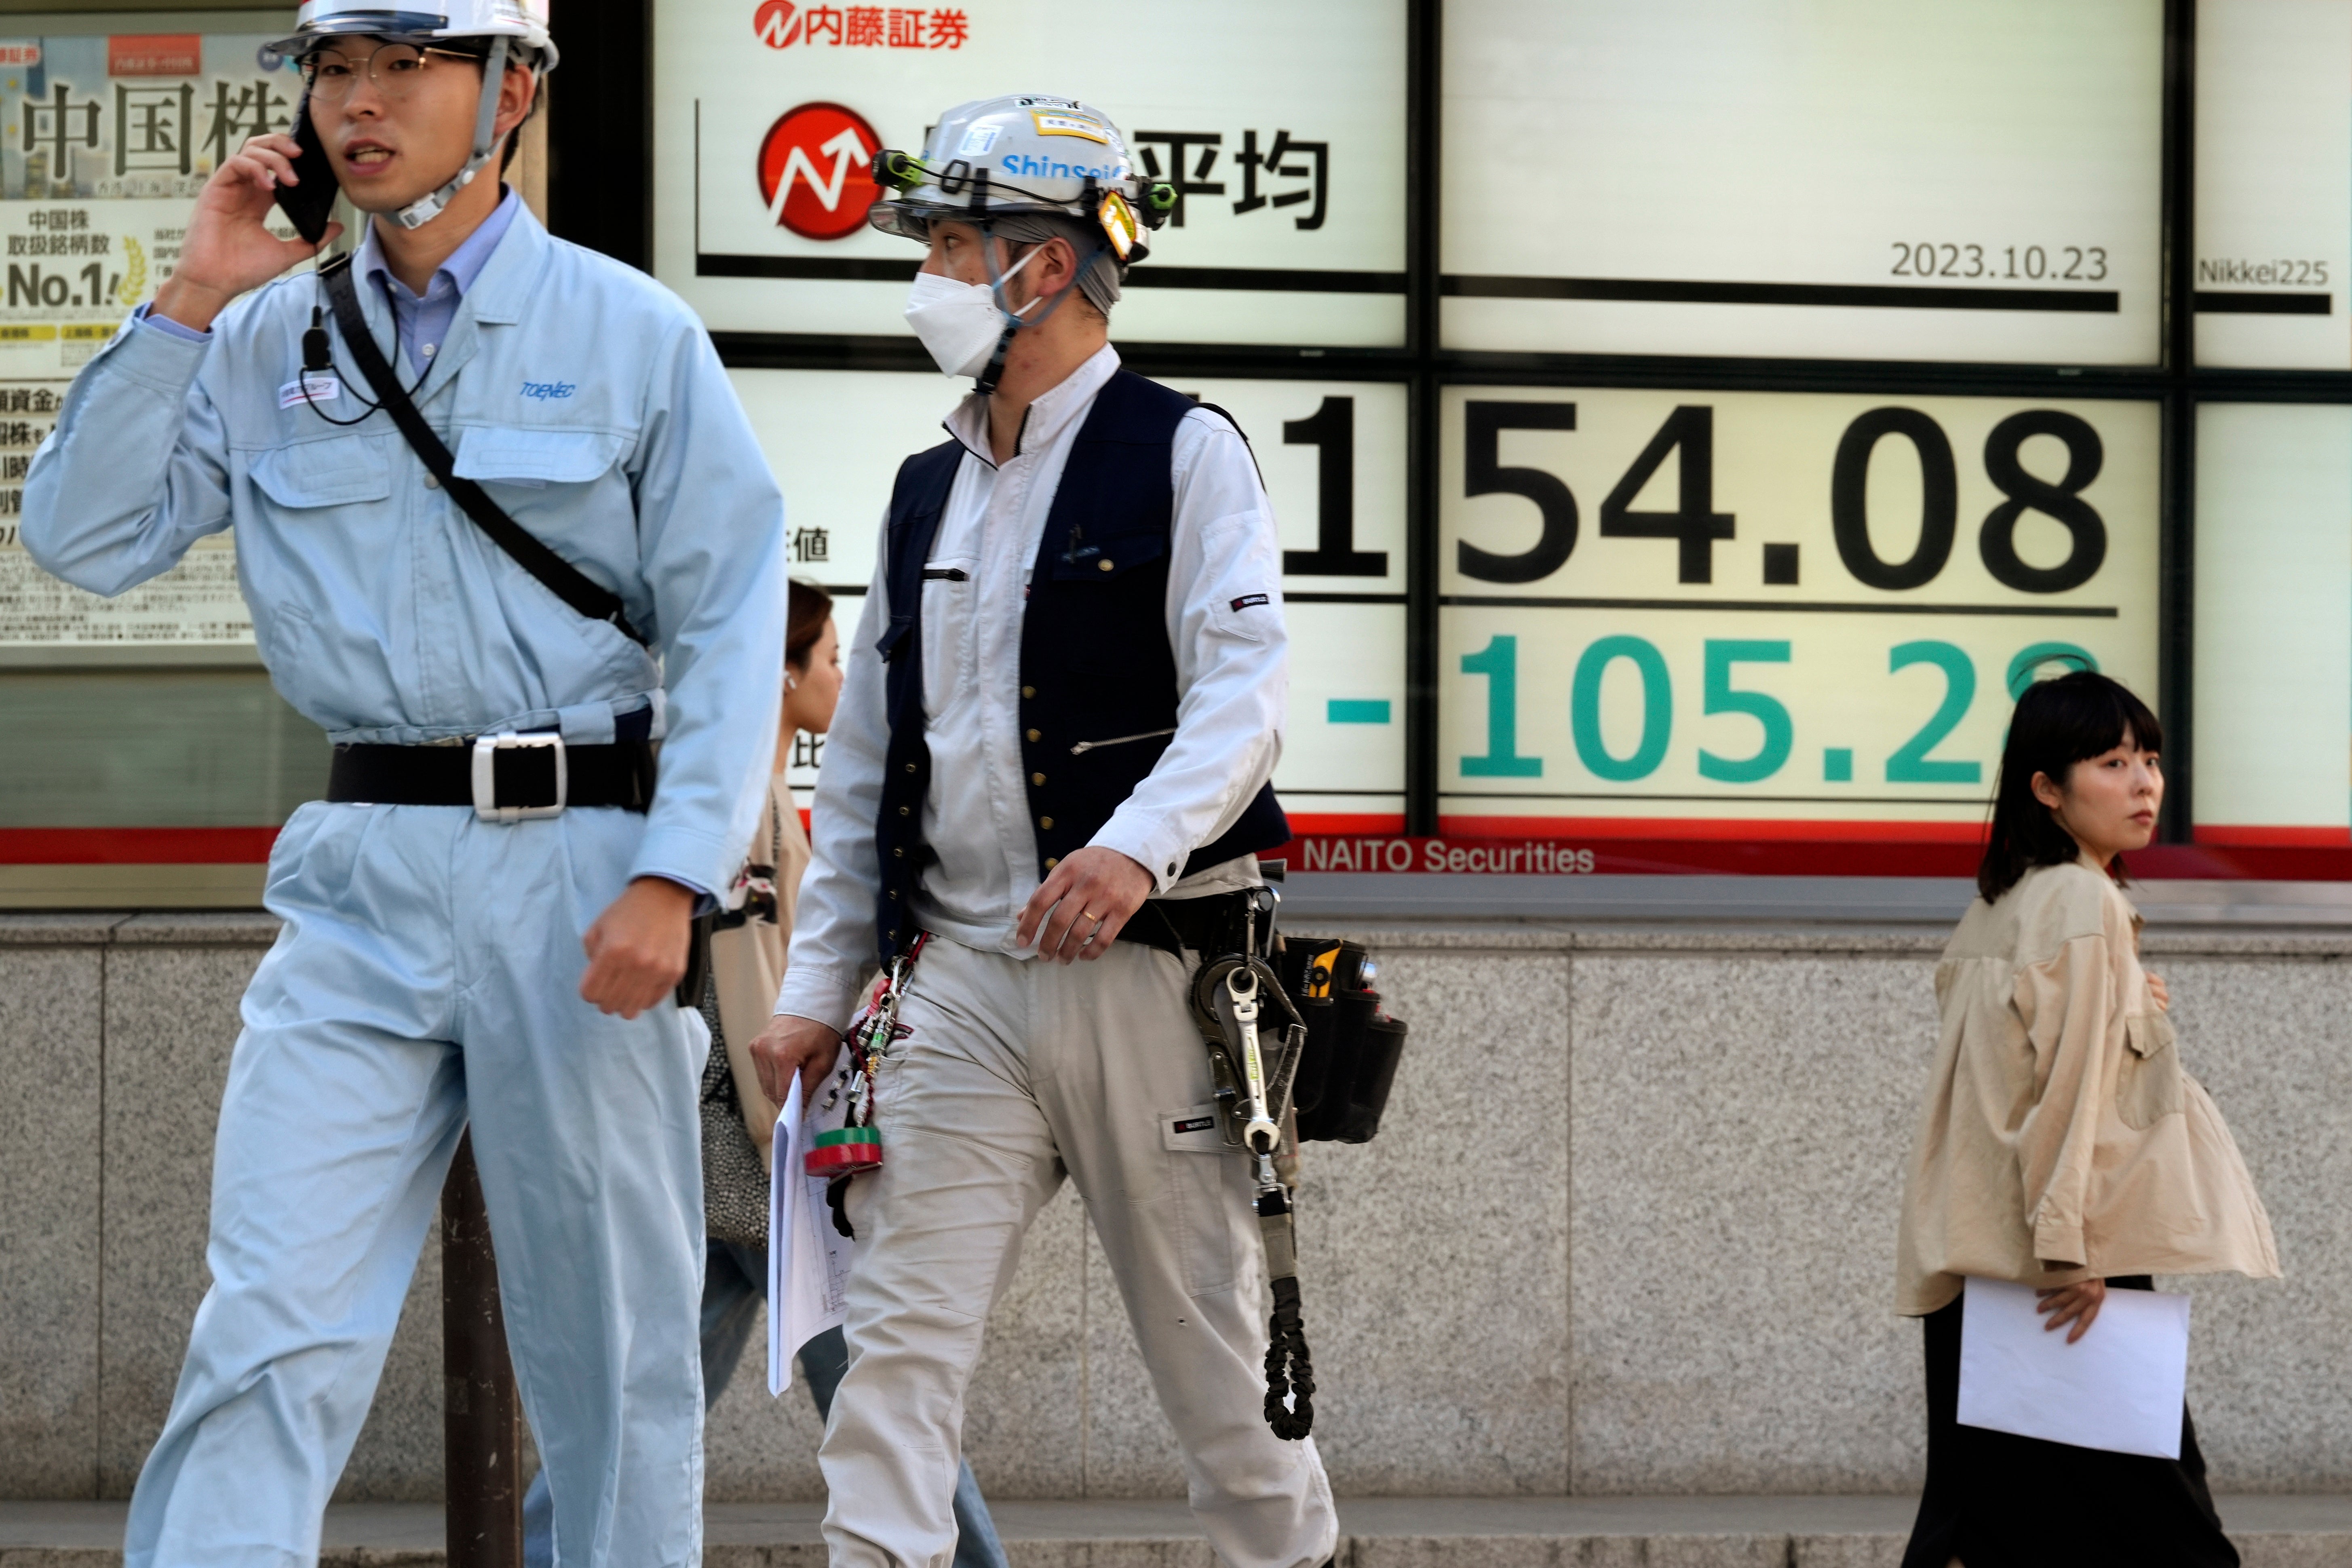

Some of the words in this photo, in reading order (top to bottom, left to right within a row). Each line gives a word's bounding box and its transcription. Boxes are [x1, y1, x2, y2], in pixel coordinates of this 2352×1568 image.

[806, 5, 968, 49] 内藤証券
[22, 80, 290, 179] 中国株
[29, 210, 89, 230] 中国株
[1891, 243, 2107, 280] 2023.10.23
[2198, 259, 2329, 285] Nikkei225
[785, 526, 829, 562] 値
[1303, 838, 1413, 871] NAITO
[1424, 840, 1595, 873] Securities
